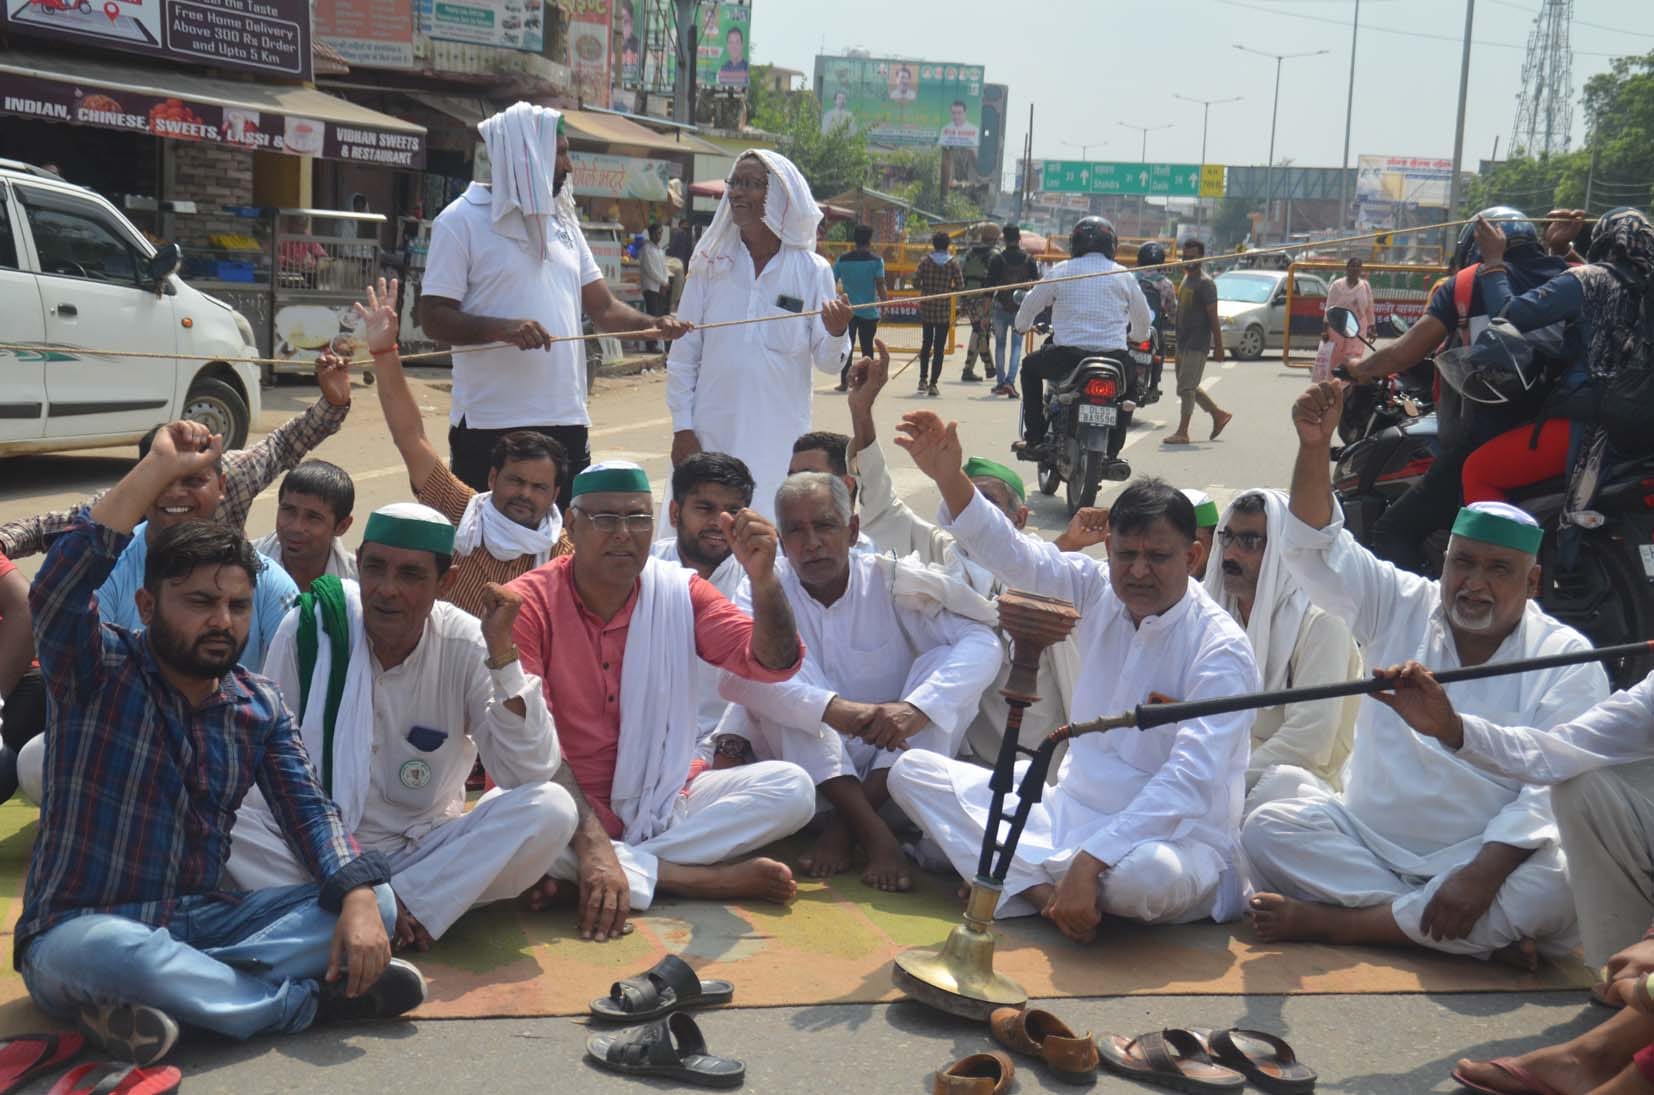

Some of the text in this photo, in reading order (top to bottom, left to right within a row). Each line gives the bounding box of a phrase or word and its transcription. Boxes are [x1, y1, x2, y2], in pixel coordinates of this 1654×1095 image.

[247, 0, 279, 16] Taste
[175, 5, 294, 40] Free Home Delivery
[173, 20, 296, 53] Above 300 Rs Order
[192, 41, 280, 64] and Upto 5 Km
[5, 96, 71, 120] INDIAN,
[78, 107, 150, 131] CHINESE,
[156, 118, 222, 141] SWEETS,
[379, 133, 419, 151] SWEETS
[341, 144, 413, 165] & RESTAURANT
